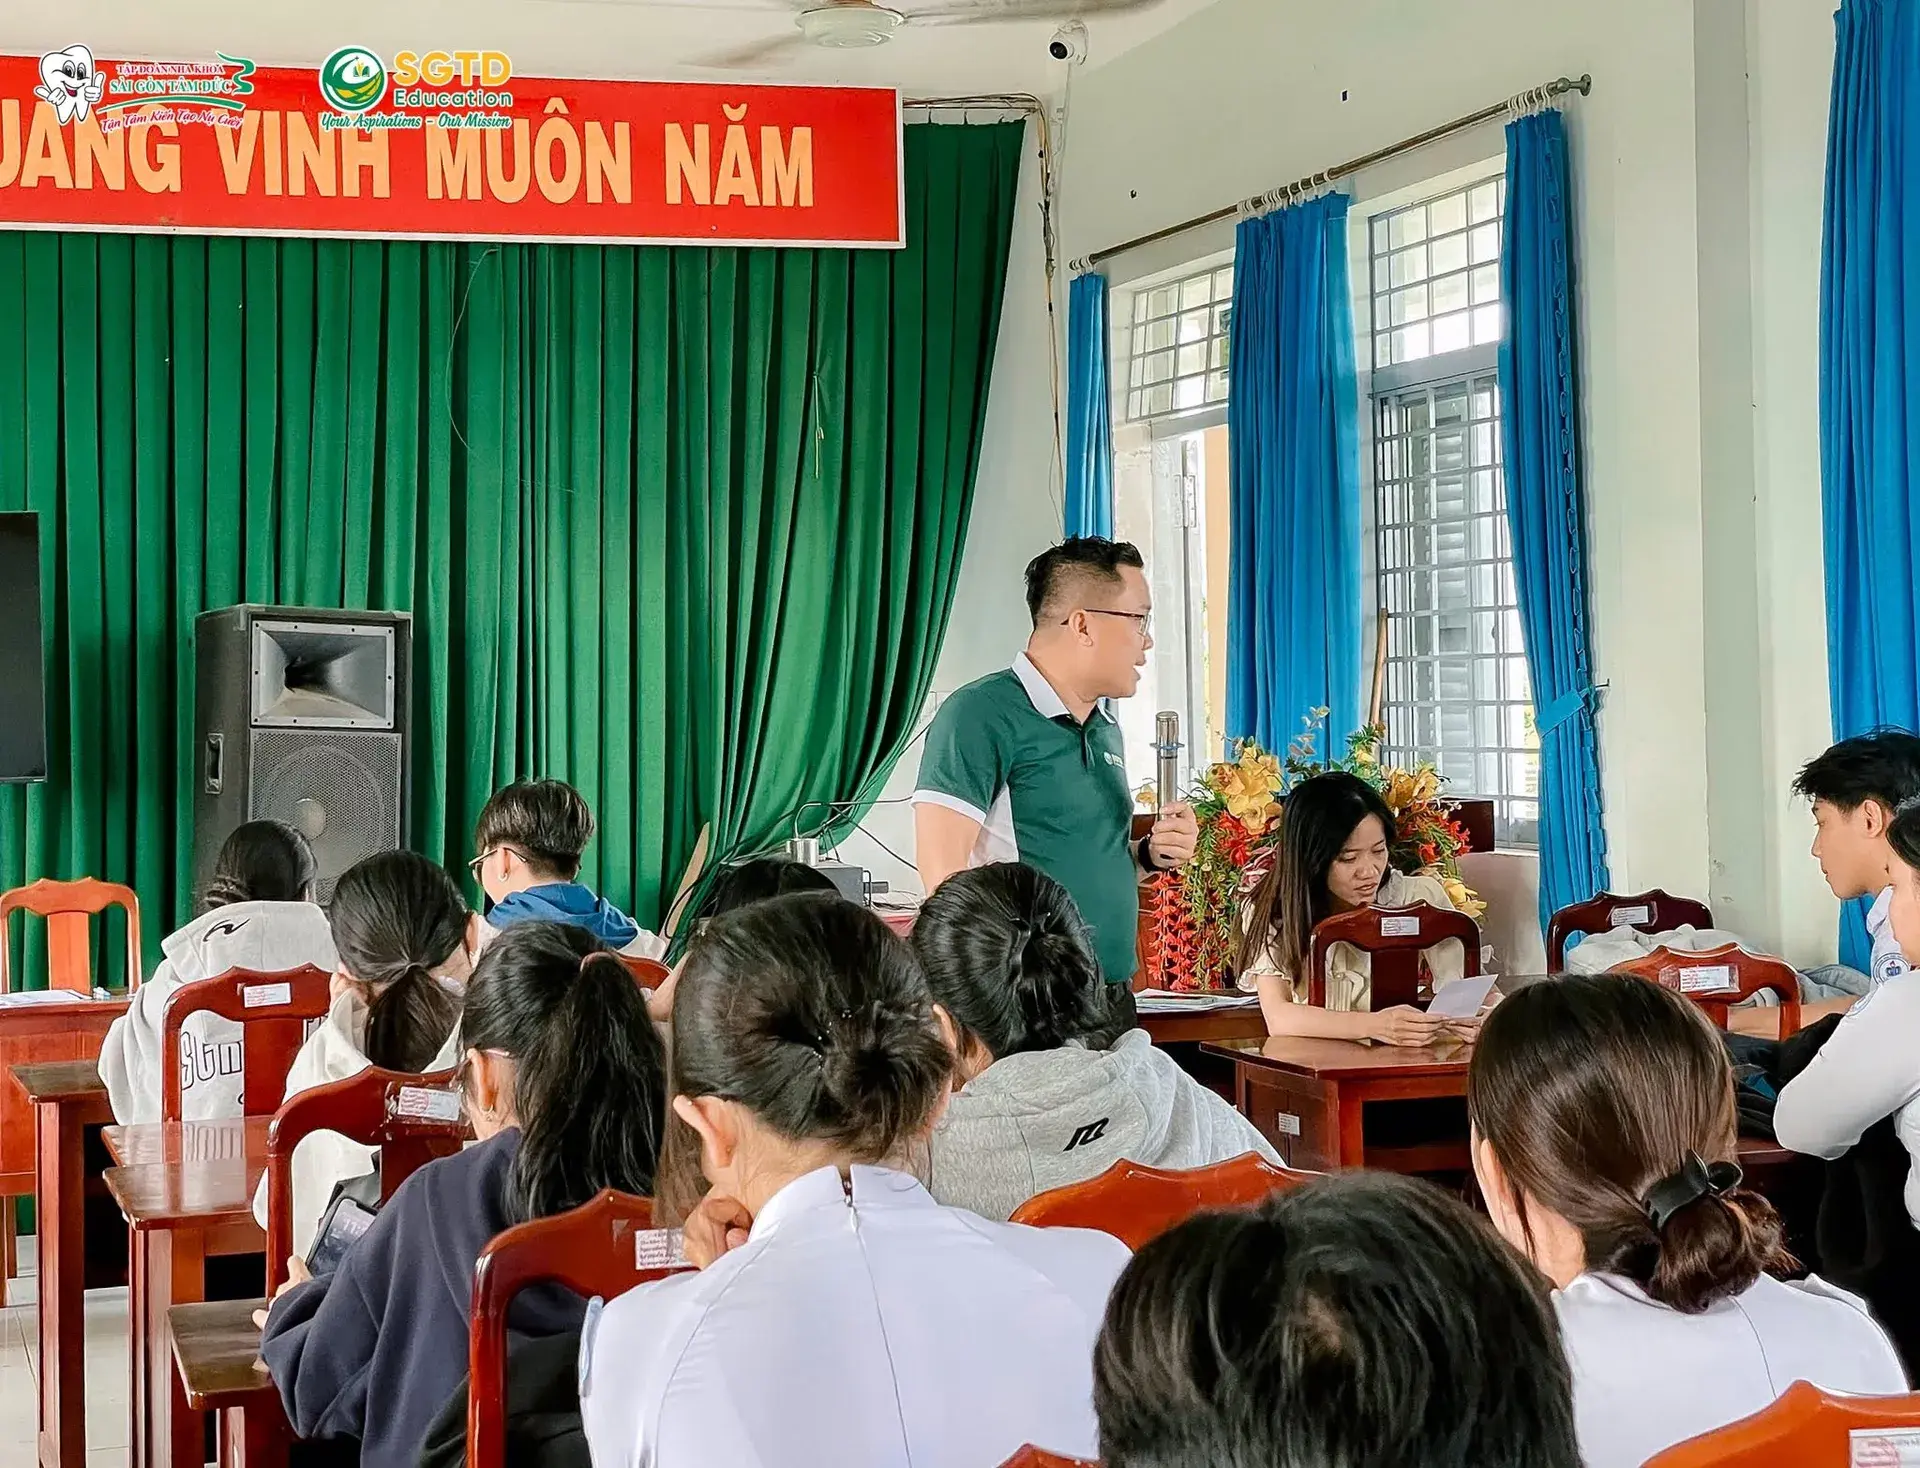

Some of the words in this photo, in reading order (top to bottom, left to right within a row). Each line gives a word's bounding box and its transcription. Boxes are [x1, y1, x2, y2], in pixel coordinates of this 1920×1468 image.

[211, 108, 391, 198] VINH
[425, 97, 632, 204] MUÔN
[664, 103, 814, 208] NĂM
